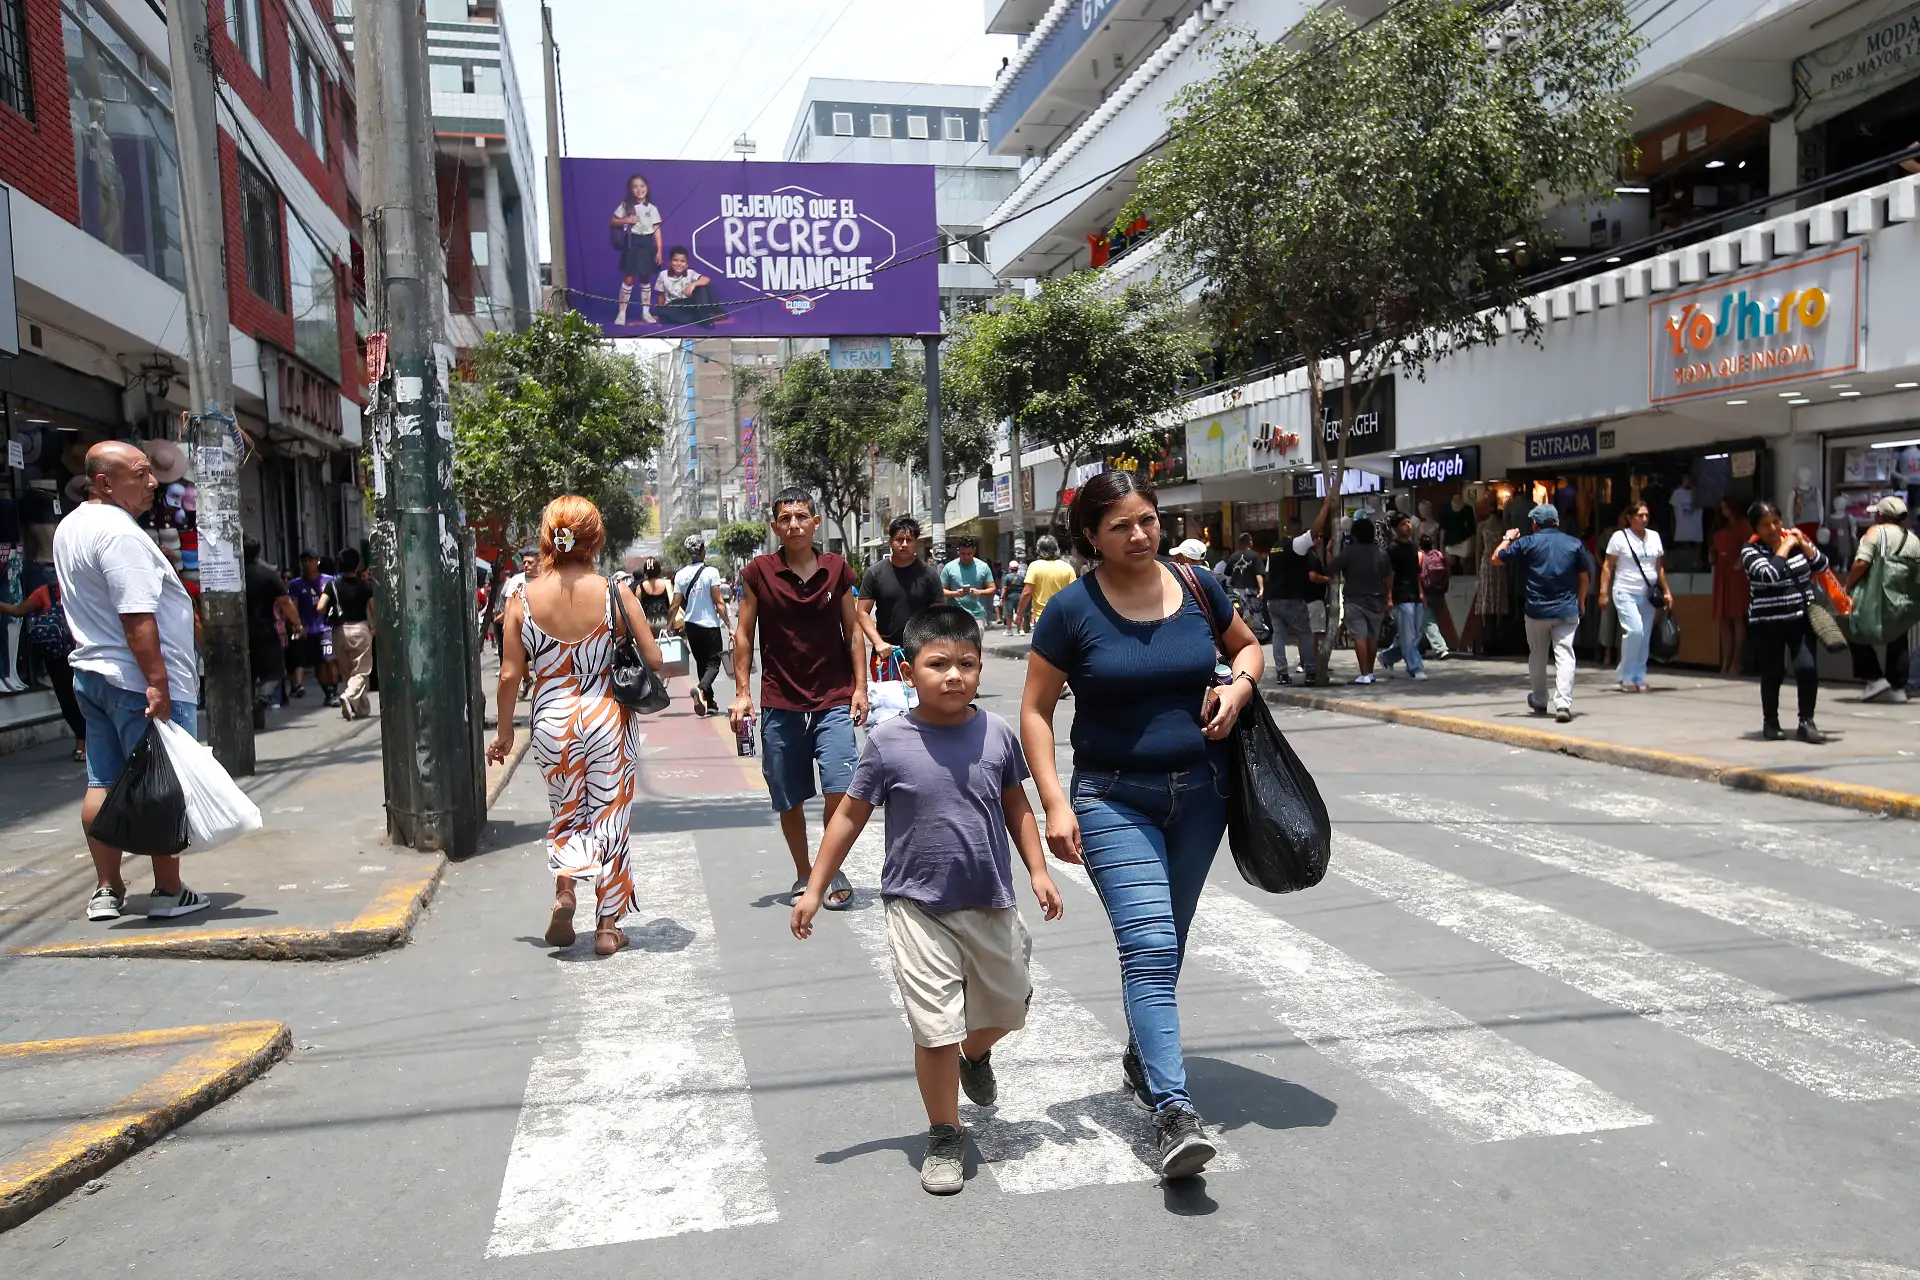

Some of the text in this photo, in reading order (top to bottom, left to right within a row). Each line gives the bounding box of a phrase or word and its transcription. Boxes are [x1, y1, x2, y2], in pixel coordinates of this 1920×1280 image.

[1866, 16, 1920, 56] MODA
[1830, 67, 1854, 89] POR
[1857, 47, 1902, 77] MAYOR
[720, 194, 857, 220] DEJEMOS QUE EL
[723, 216, 861, 257] RECREO
[725, 256, 874, 291] LOS MANCHE
[840, 350, 881, 361] TEAM
[1673, 344, 1814, 385] MODA QUE INNOVA
[1530, 434, 1591, 457] ENTRADA
[1399, 453, 1464, 483] Verdageh
